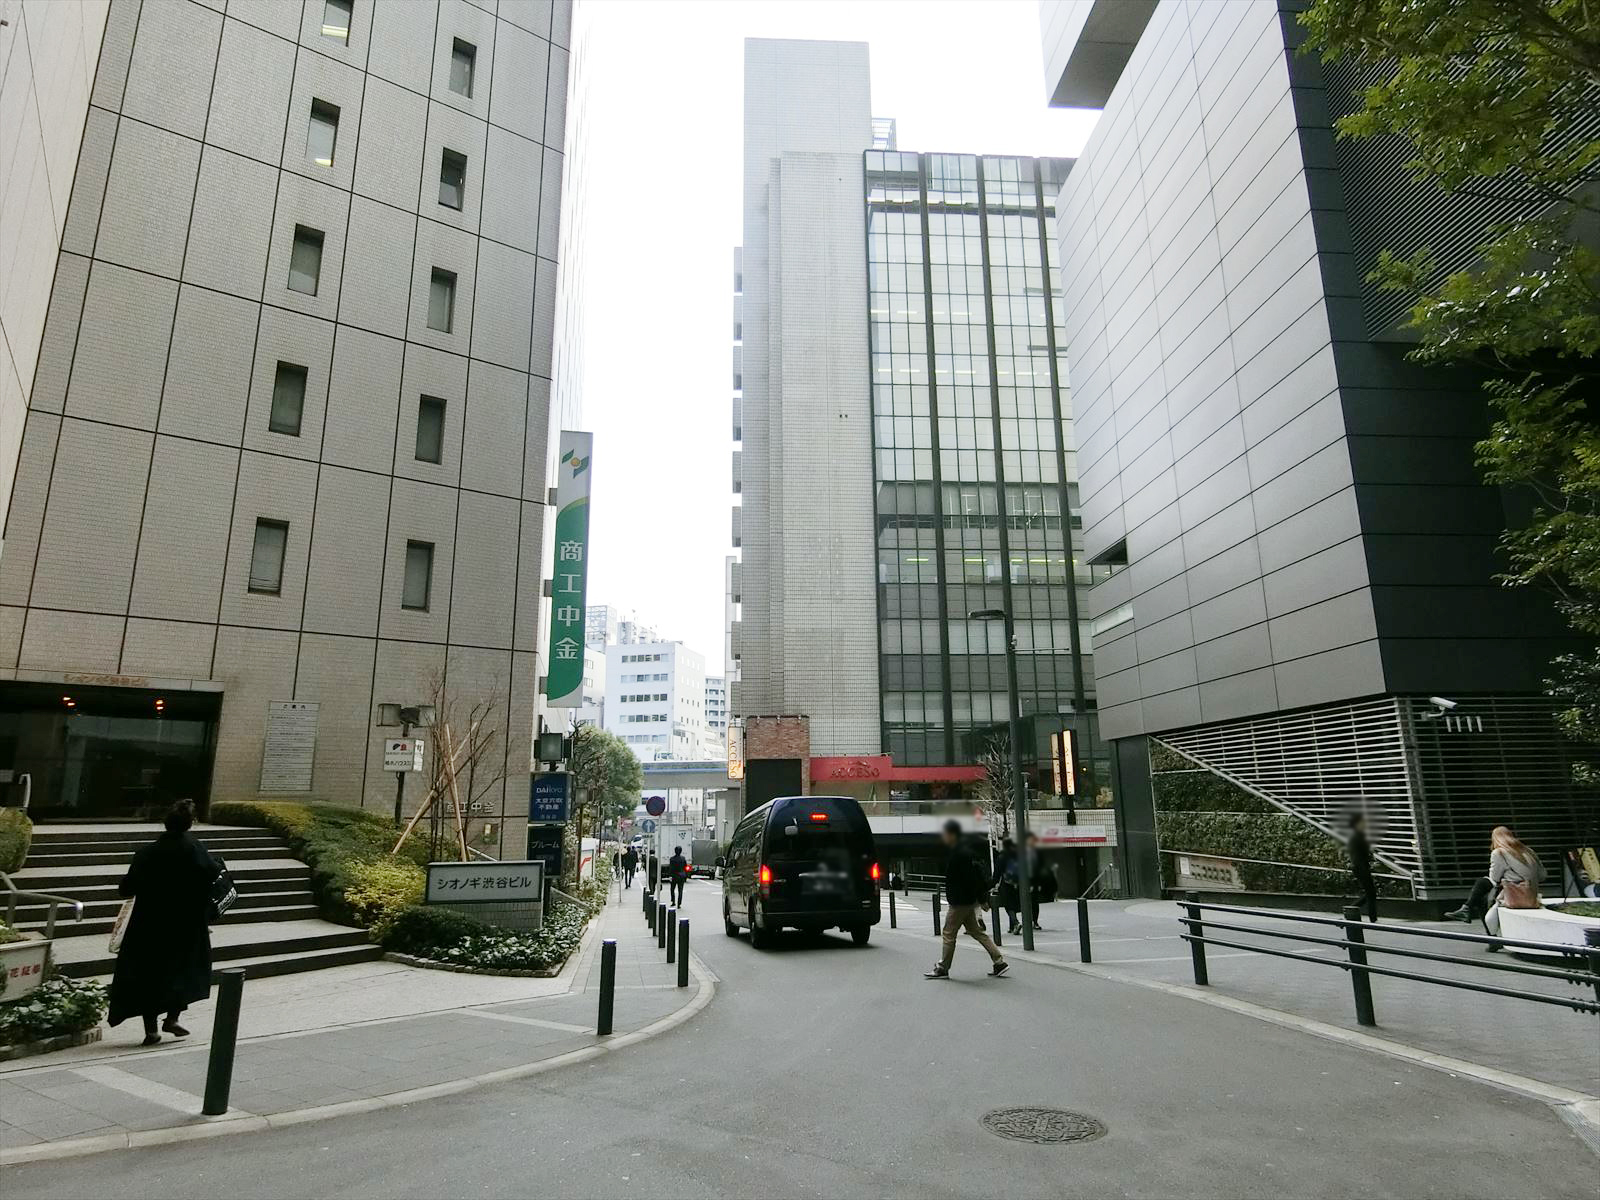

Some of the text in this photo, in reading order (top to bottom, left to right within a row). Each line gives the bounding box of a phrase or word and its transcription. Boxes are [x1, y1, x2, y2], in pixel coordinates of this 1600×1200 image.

[555, 541, 583, 659] 商工中金
[729, 739, 738, 778] ACCESO
[830, 767, 880, 778] ACCESO
[438, 876, 532, 890] シオノギ渋谷ビル
